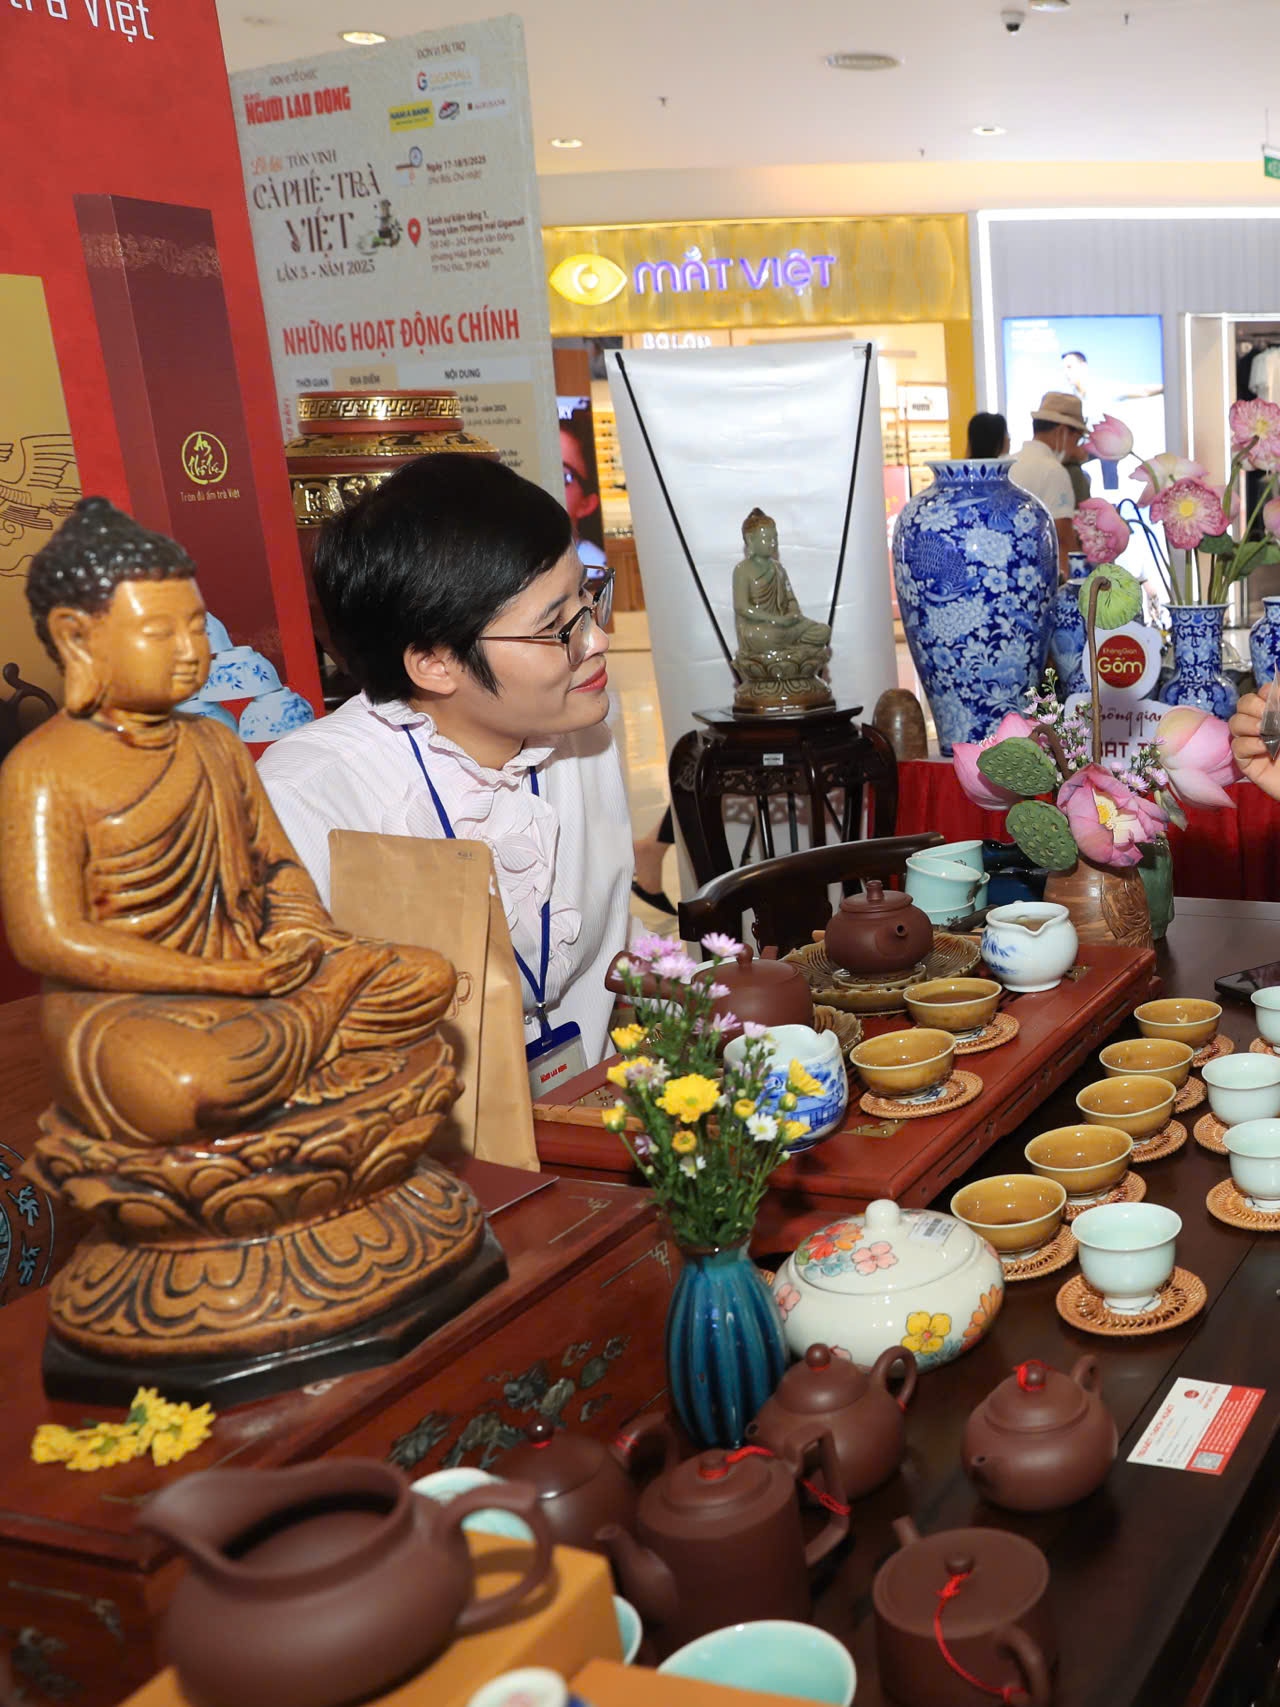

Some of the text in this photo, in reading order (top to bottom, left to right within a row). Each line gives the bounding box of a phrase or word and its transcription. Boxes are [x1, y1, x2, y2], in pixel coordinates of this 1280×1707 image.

[286, 92, 312, 119] LAO
[285, 206, 354, 258] VIỆT
[347, 258, 376, 276] 2025
[634, 245, 837, 297] MẮT VIỆT
[283, 304, 520, 357] NHỮNG HOẠT ĐỘNG CHÍNH
[444, 367, 481, 381] NỘI DUNG
[1097, 655, 1143, 673] Gốm
